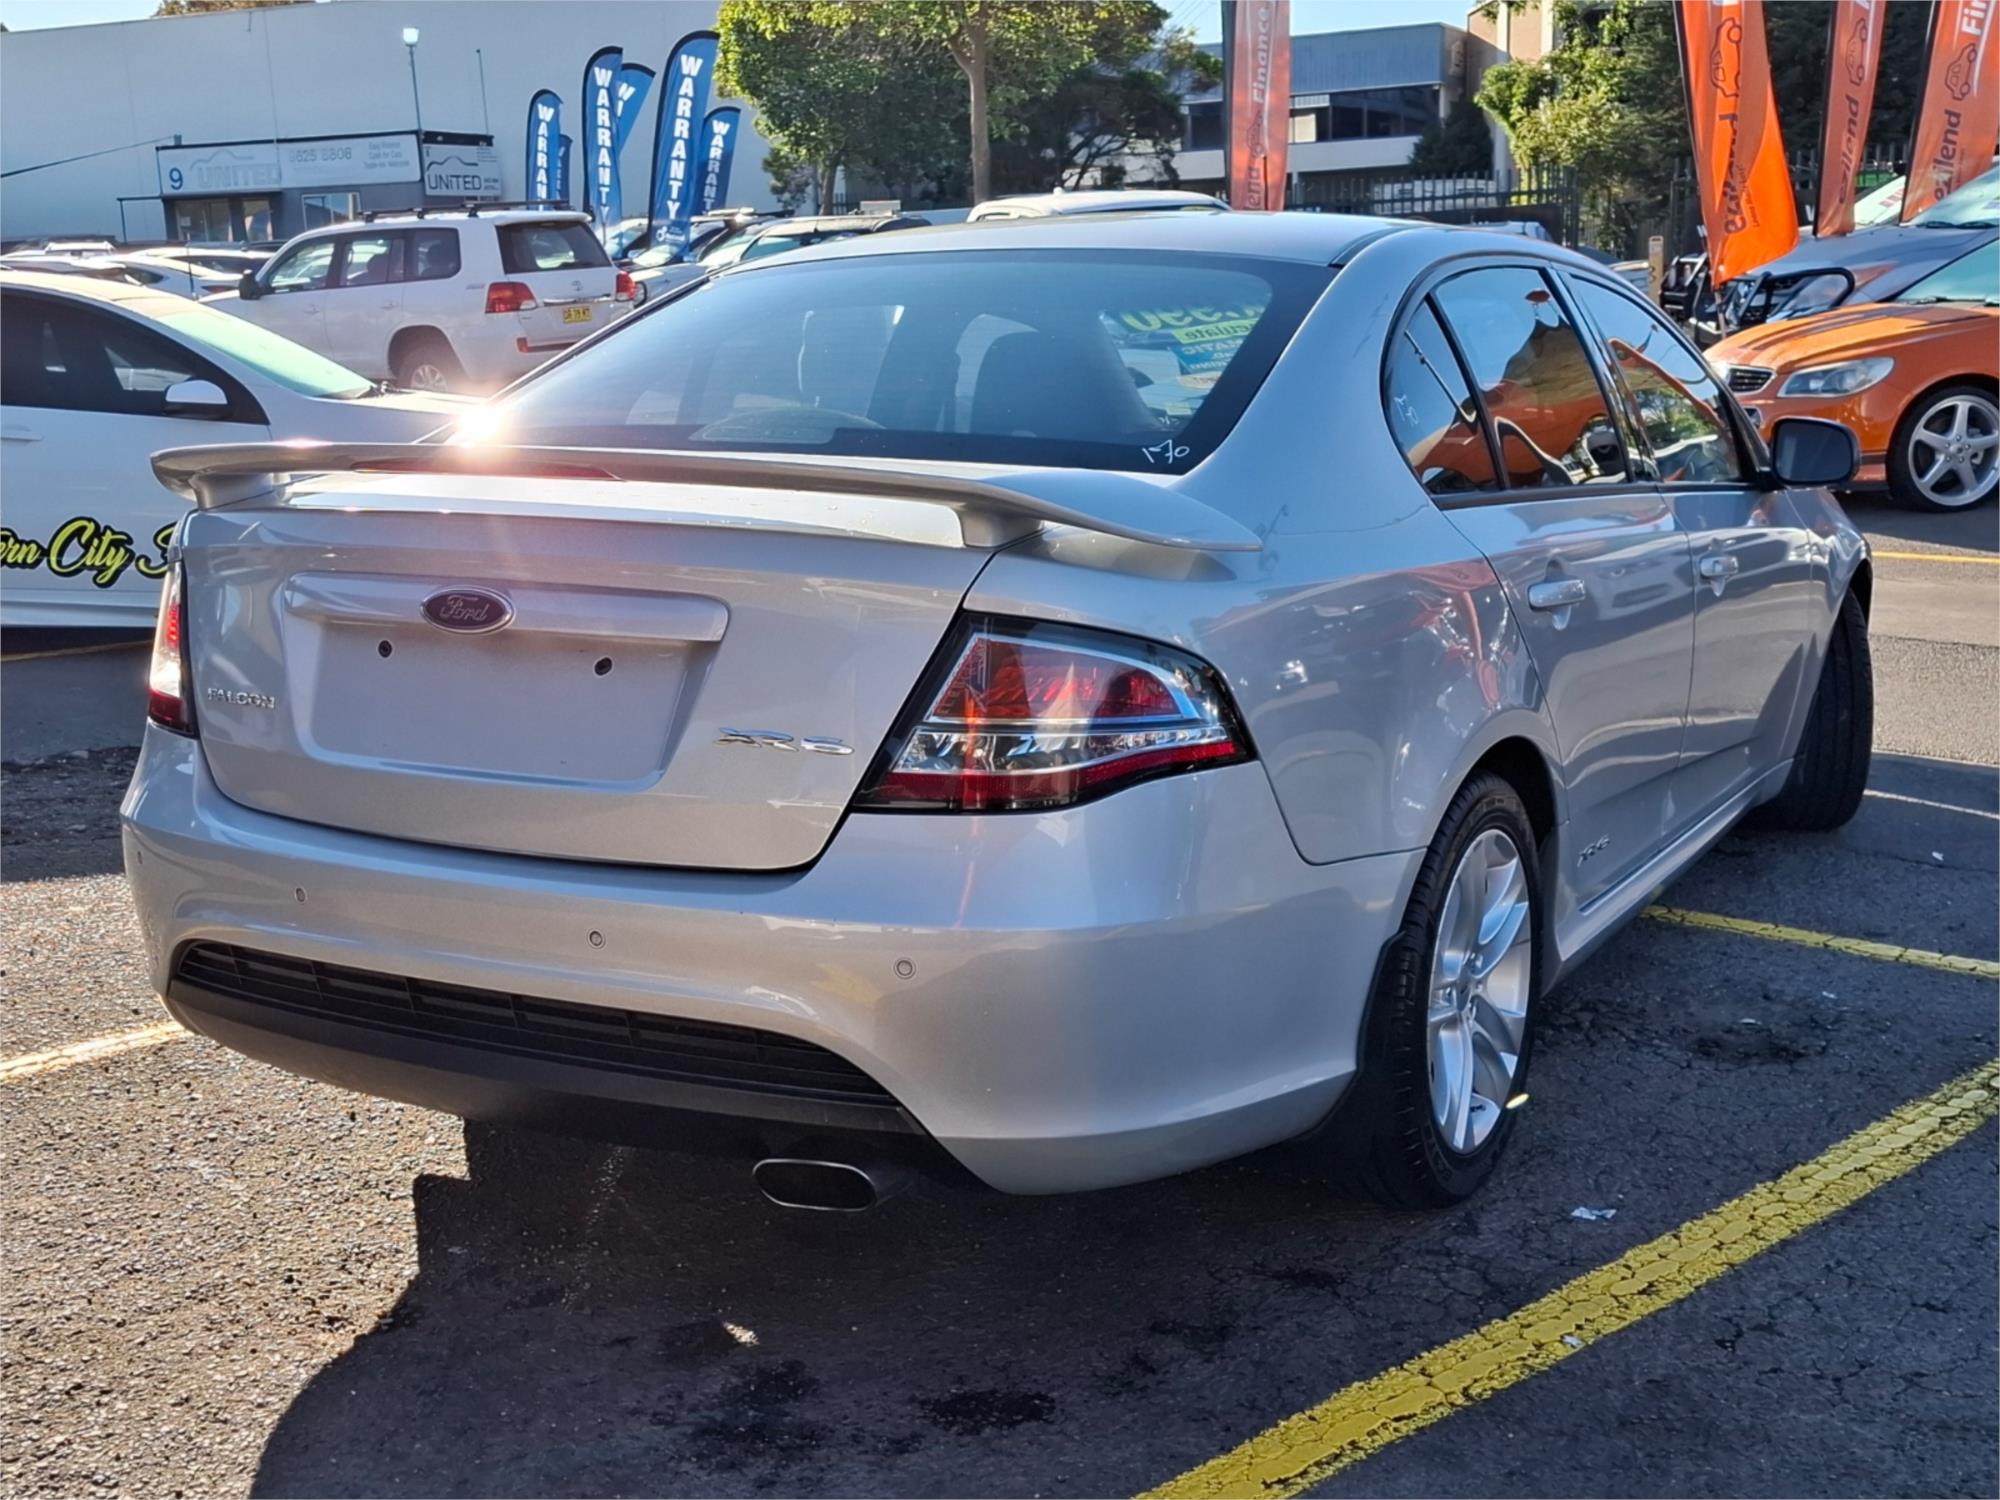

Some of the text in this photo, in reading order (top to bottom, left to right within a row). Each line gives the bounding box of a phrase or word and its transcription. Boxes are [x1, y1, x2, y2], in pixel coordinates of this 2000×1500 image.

[1253, 8, 1271, 103] Finance
[593, 66, 613, 224] WARRANTY
[667, 54, 703, 220] WARRANTY
[703, 119, 730, 215] WARRANT
[168, 168, 184, 190] 9
[49, 518, 133, 586] City
[440, 594, 490, 622] Ford
[207, 687, 275, 710] FALCON
